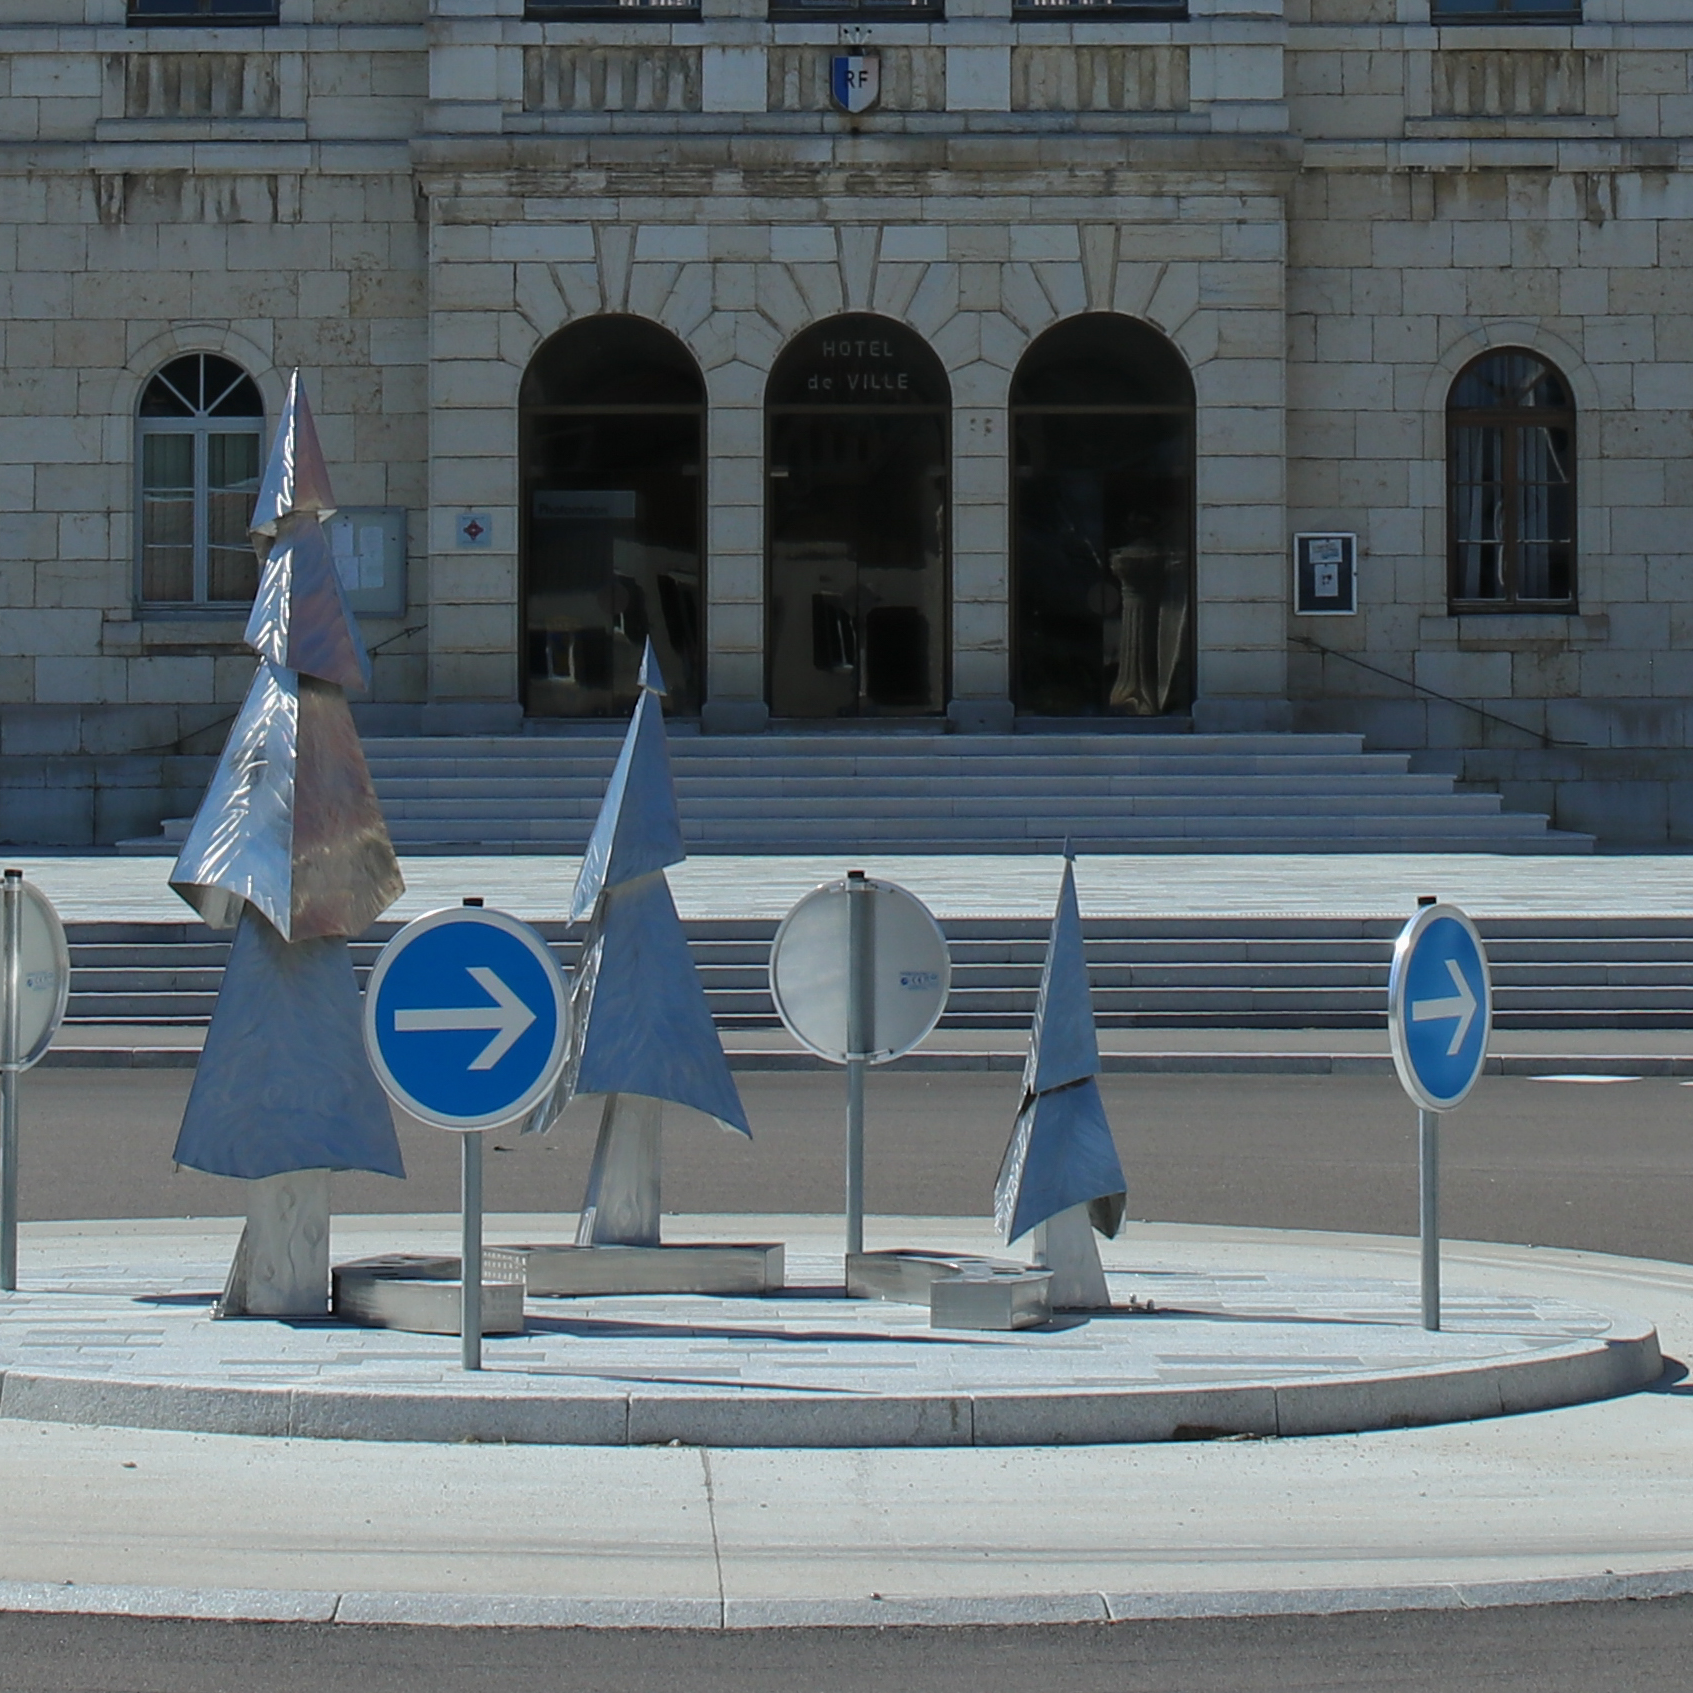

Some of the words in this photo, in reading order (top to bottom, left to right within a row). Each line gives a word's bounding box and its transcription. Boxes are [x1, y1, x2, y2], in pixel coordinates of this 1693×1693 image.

[844, 70, 868, 89] RF
[822, 340, 893, 357] HOTEL
[808, 373, 833, 390] de
[847, 373, 908, 390] VILLE
